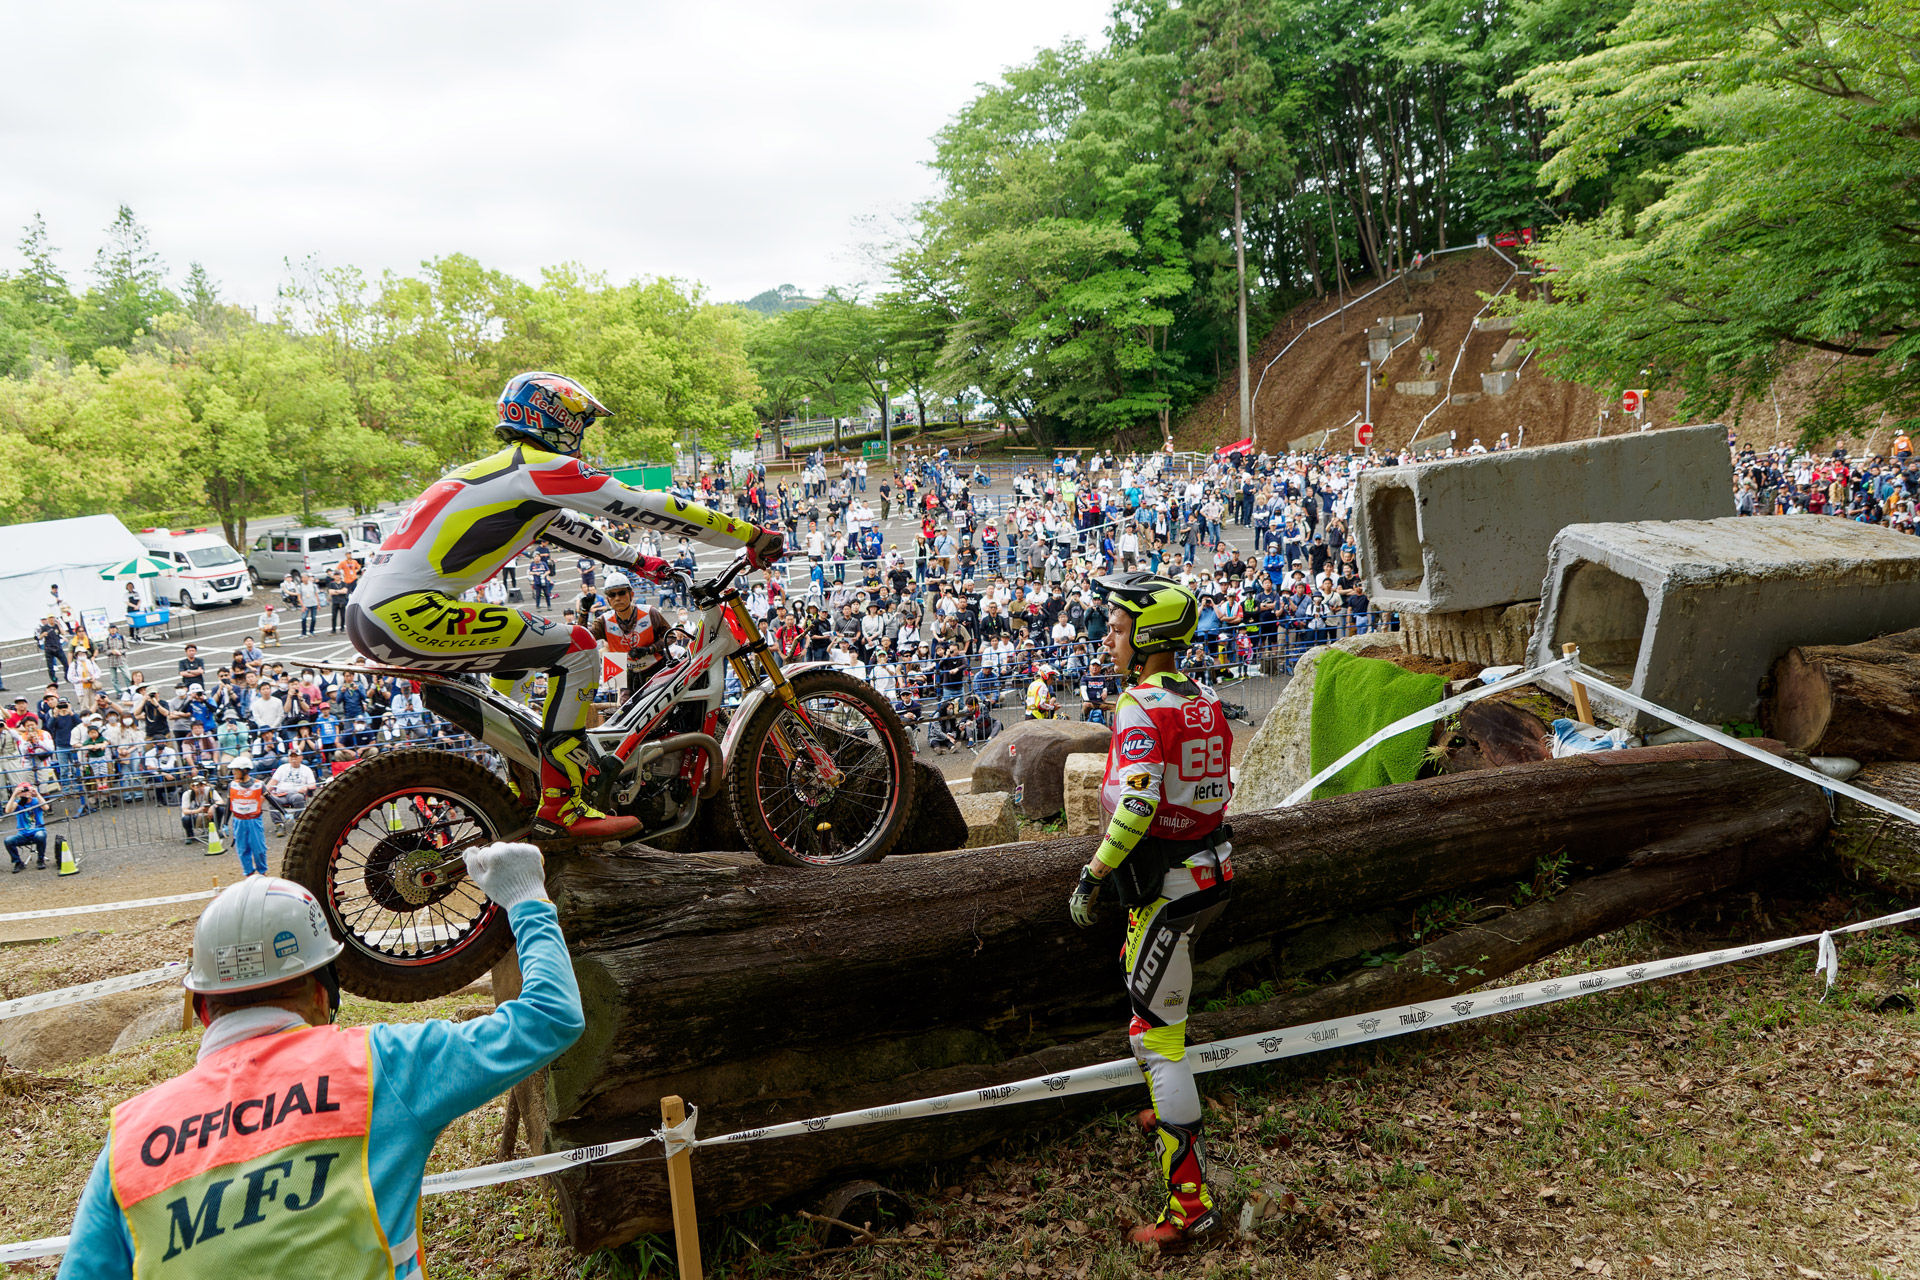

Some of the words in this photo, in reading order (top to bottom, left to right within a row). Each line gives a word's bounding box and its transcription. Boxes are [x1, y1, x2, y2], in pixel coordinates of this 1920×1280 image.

[529, 391, 558, 417] Red
[555, 408, 583, 435] Bull
[551, 515, 603, 546] MOTS
[603, 499, 703, 537] MOTS
[389, 612, 501, 648] MOTORCYCLES
[1122, 739, 1156, 754] NILS
[1181, 735, 1224, 777] 68
[1200, 861, 1232, 880] MTS
[1134, 926, 1174, 996] MOTS
[1579, 977, 1603, 990] TRIALGP
[1398, 1011, 1426, 1026] TRIALGP
[1199, 1047, 1230, 1063] TRIALGP
[977, 1086, 1011, 1102] TRIALGP
[140, 1075, 340, 1167] OFFICIAL
[571, 1144, 609, 1161] TRIALGP
[161, 1152, 340, 1263] MFJ
